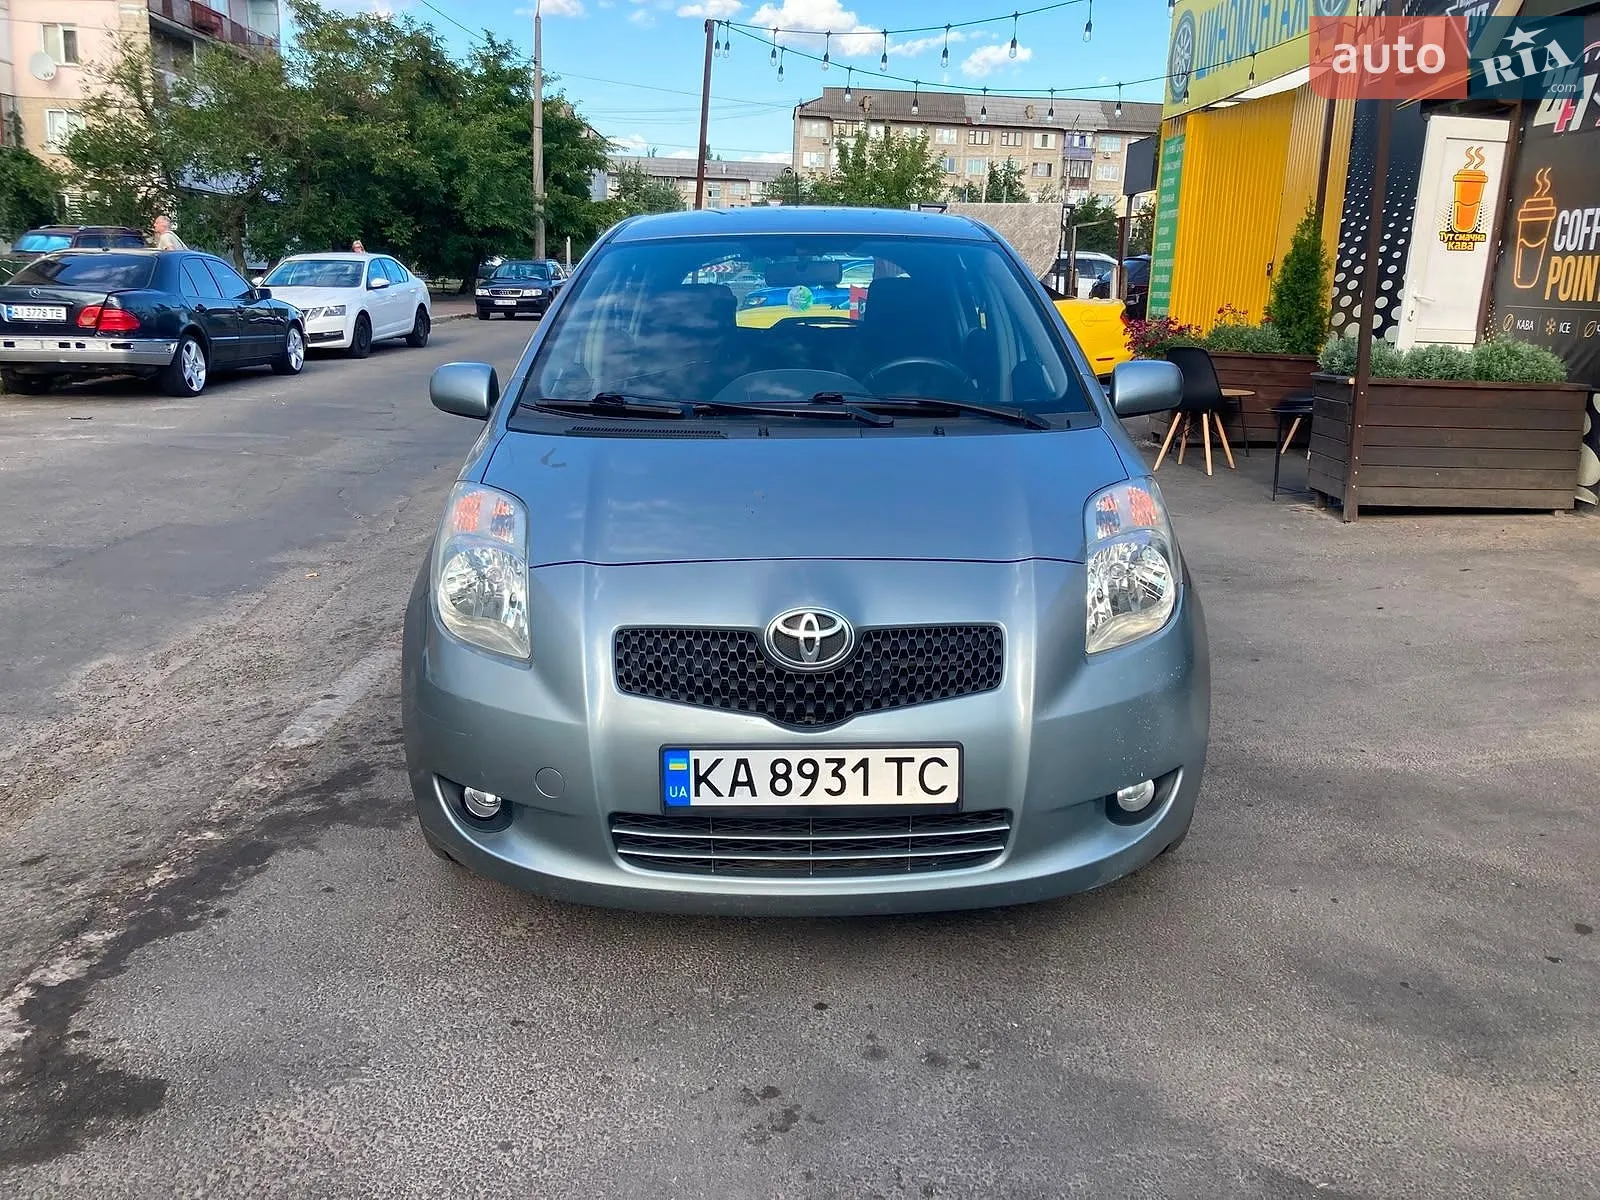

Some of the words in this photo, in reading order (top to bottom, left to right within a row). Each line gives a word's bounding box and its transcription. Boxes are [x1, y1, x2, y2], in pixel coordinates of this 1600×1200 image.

[1440, 231, 1455, 243] Тут
[1454, 233, 1486, 242] смачна
[1544, 255, 1600, 302] POIN
[1558, 322, 1572, 334] ICE
[693, 758, 758, 798] KA
[769, 757, 869, 798] 8931
[884, 757, 949, 797] TC
[669, 786, 688, 799] UA
